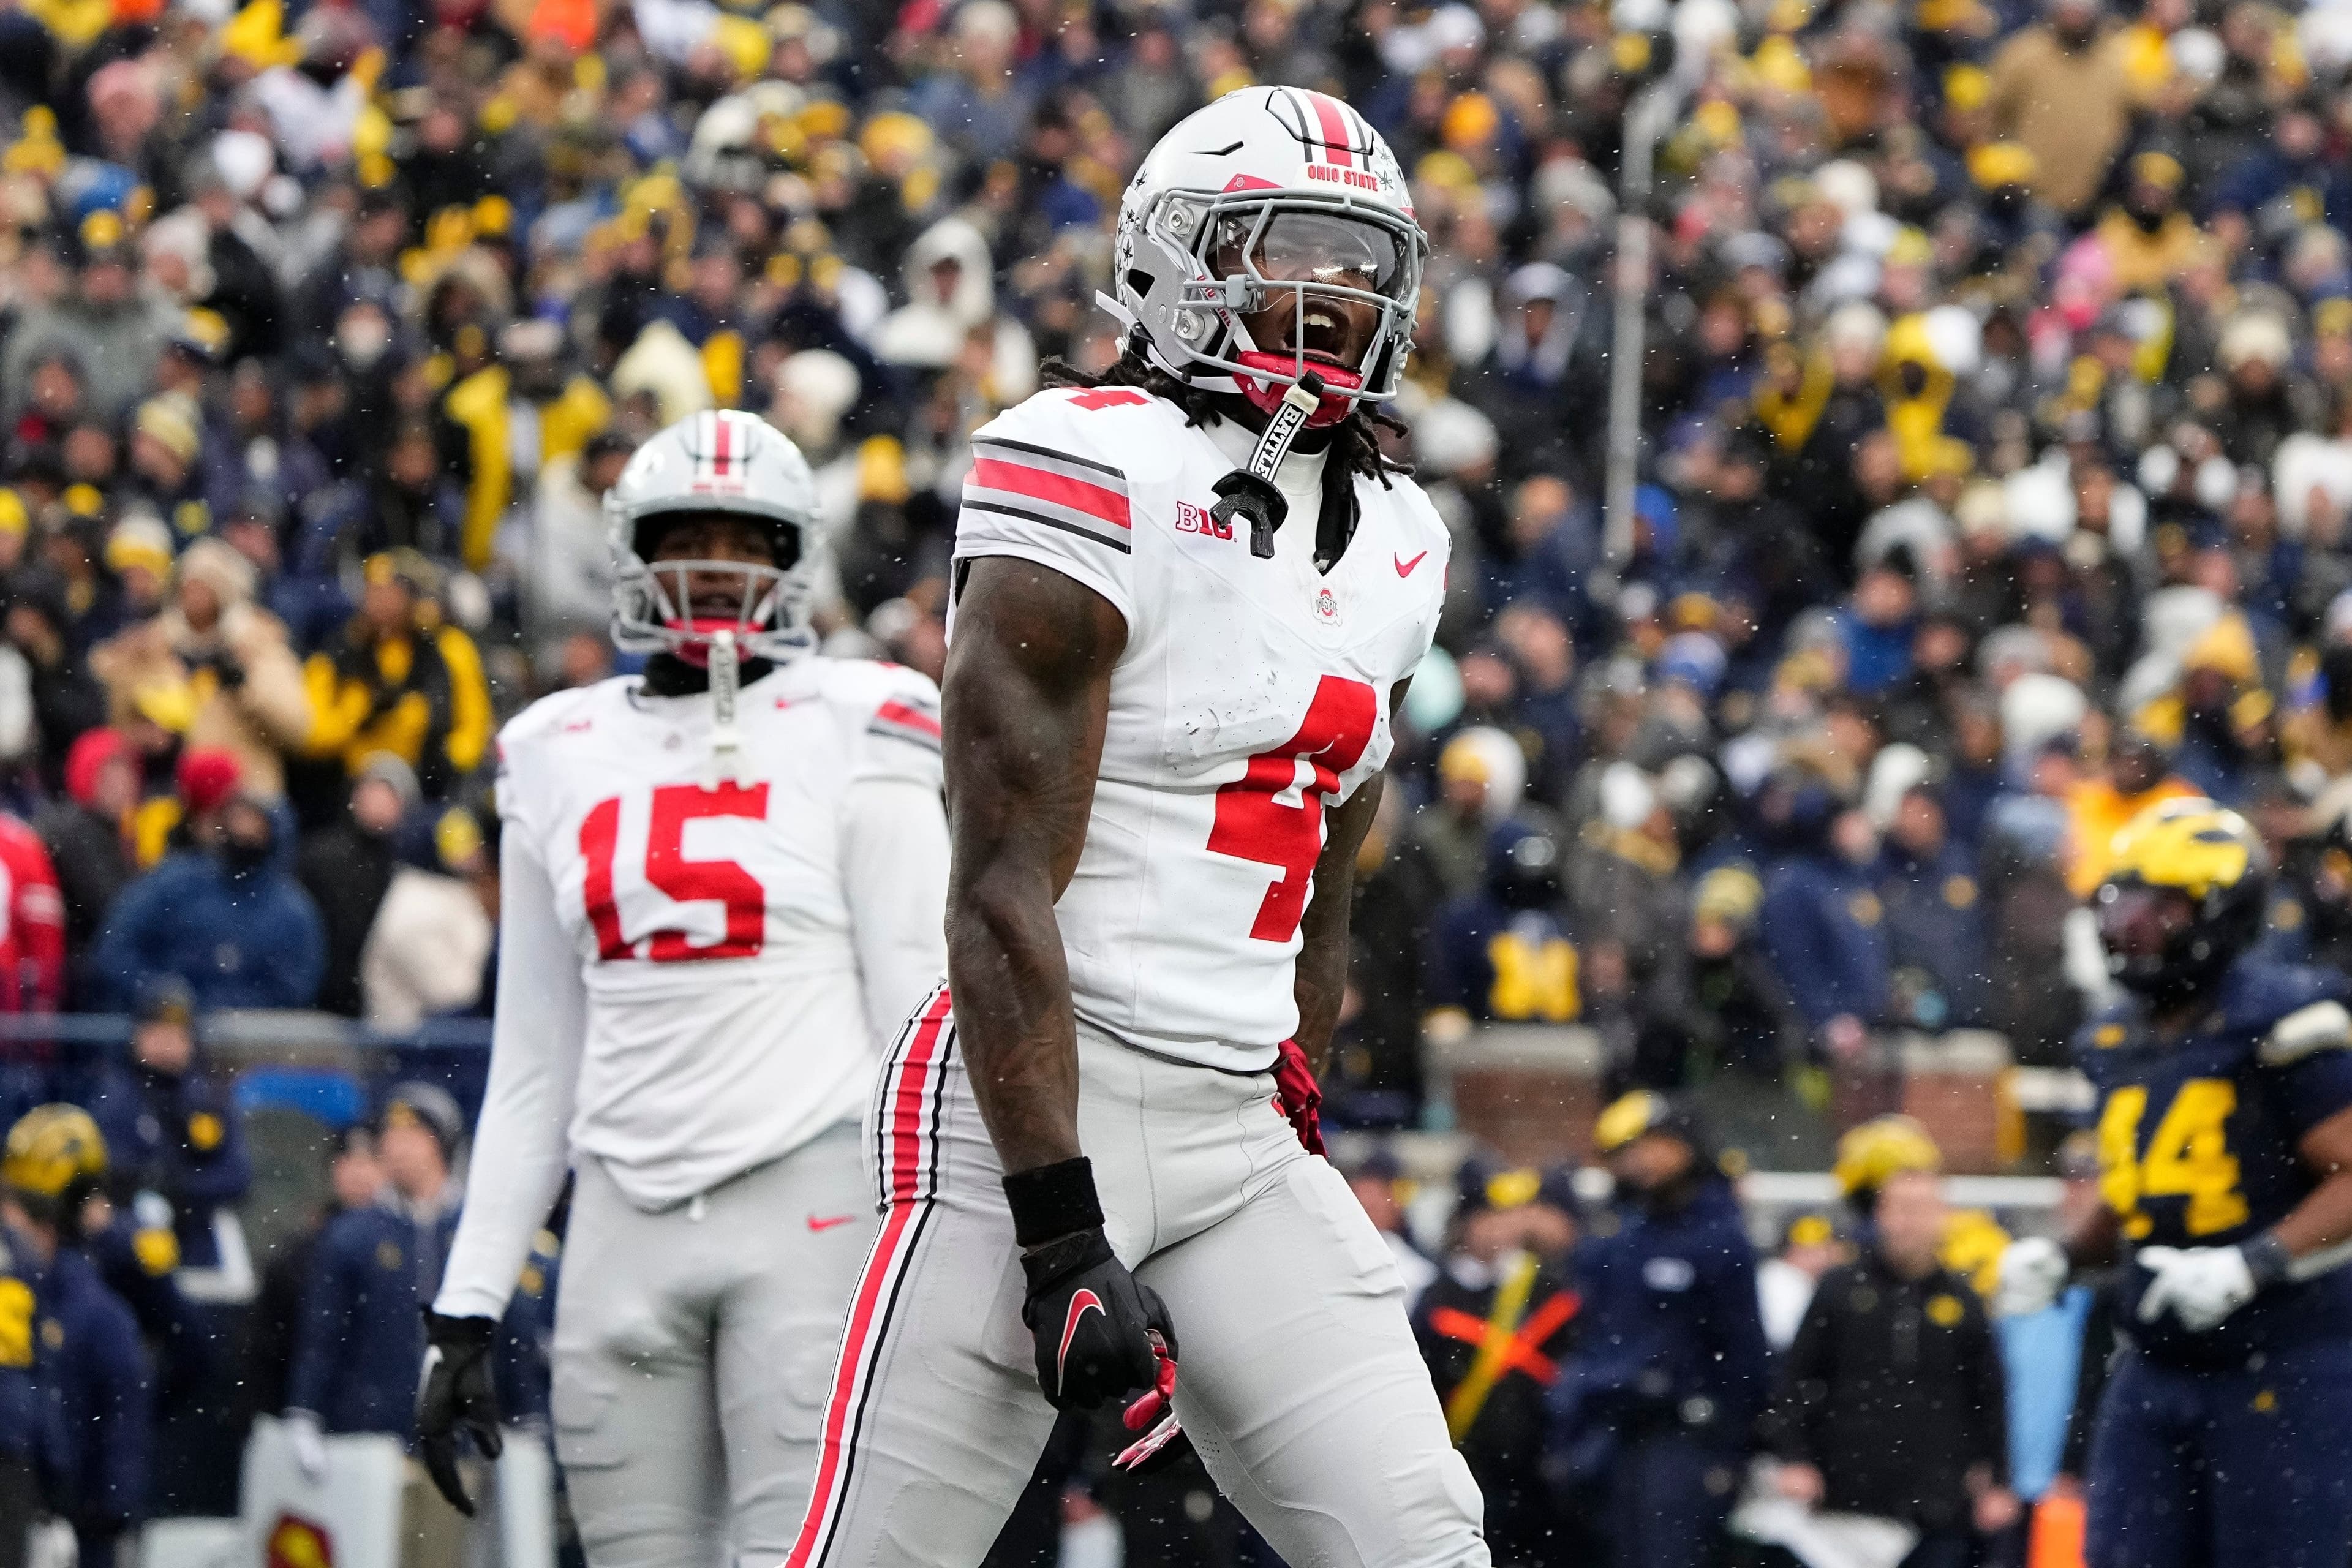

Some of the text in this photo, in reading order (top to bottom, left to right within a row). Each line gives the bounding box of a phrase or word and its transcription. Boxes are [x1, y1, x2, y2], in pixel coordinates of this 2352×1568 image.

[1308, 165, 1378, 192] OHIO STATE
[1255, 405, 1302, 478] BATTLE
[579, 780, 769, 962] 15
[1206, 674, 1377, 943] 4
